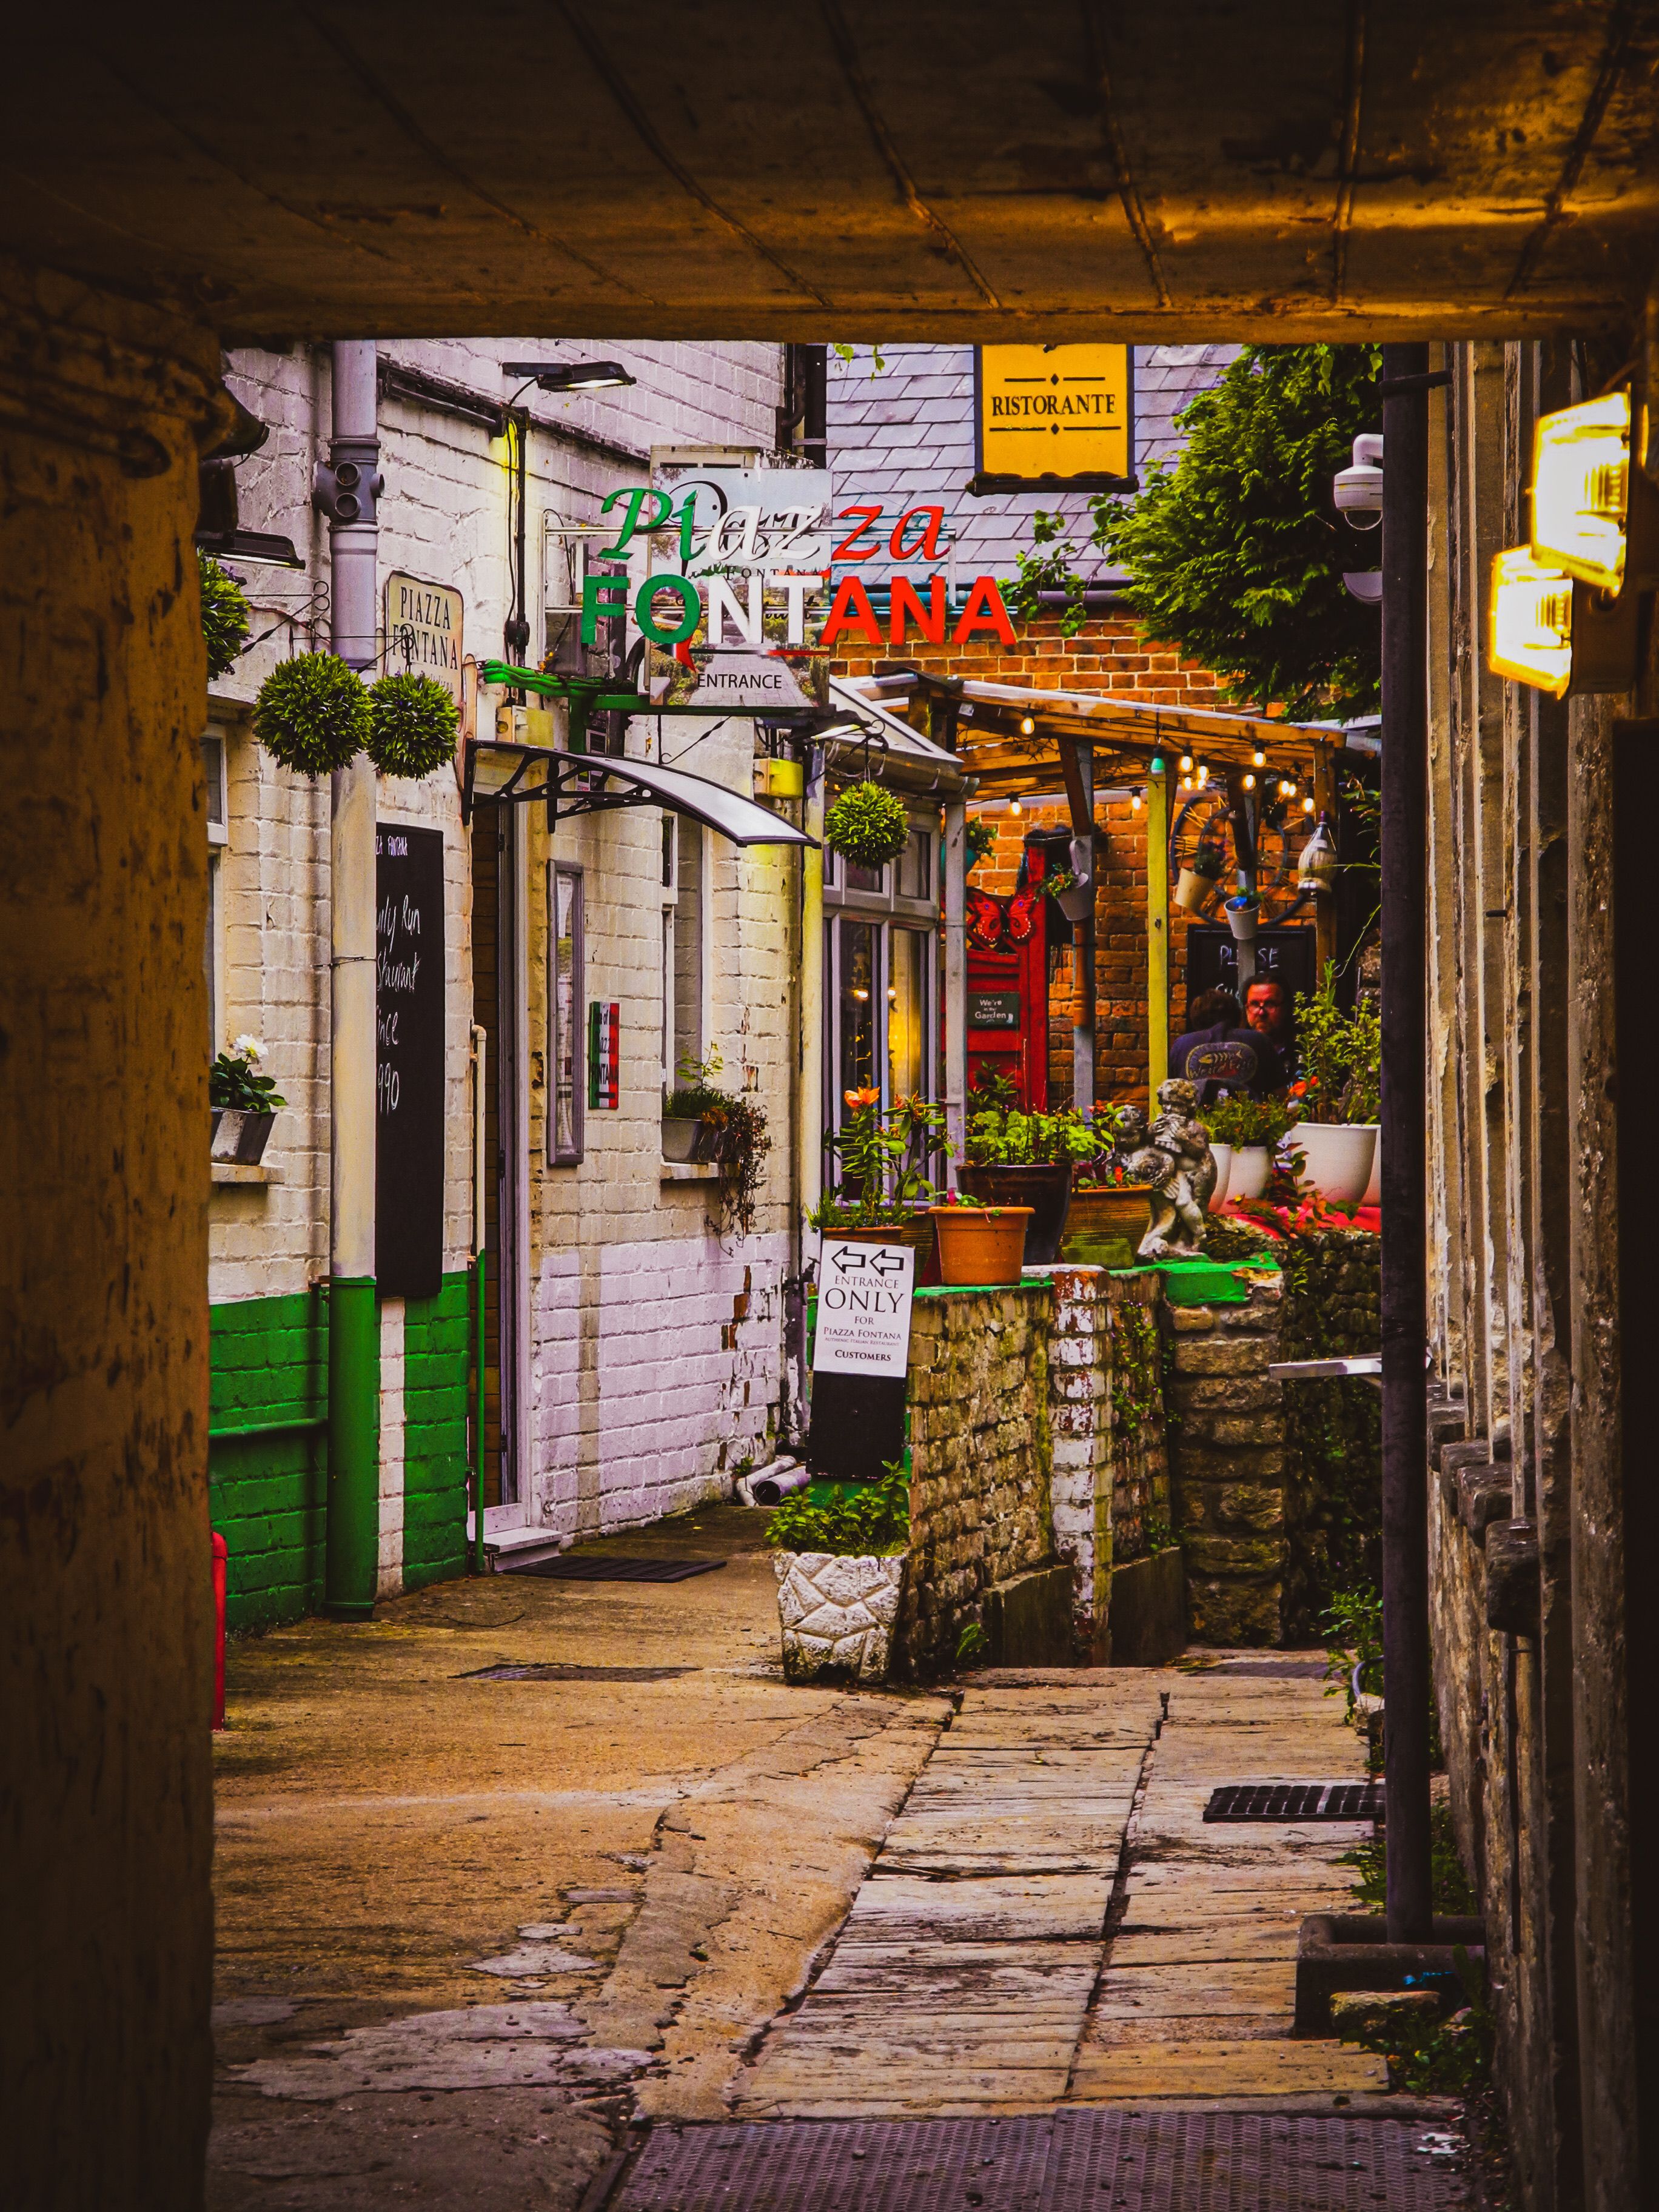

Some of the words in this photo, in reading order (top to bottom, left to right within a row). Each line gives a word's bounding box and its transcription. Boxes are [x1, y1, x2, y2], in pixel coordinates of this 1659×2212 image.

[991, 394, 1116, 416] RISTORANTE
[598, 487, 951, 561] Piazza
[400, 586, 451, 630] PIAZZA
[581, 574, 1017, 646] FONTANA
[392, 624, 458, 670] FONTANA
[697, 673, 782, 689] ENTRANCE
[1220, 945, 1279, 968] PLSE
[378, 1063, 399, 1114] 990
[834, 1275, 899, 1289] ENTRANCE
[825, 1288, 905, 1313] ONLY
[854, 1316, 874, 1325] FOR
[823, 1327, 854, 1336] PIAZZA
[858, 1329, 902, 1340] FONTANA
[834, 1349, 891, 1361] CUSTOMERS
